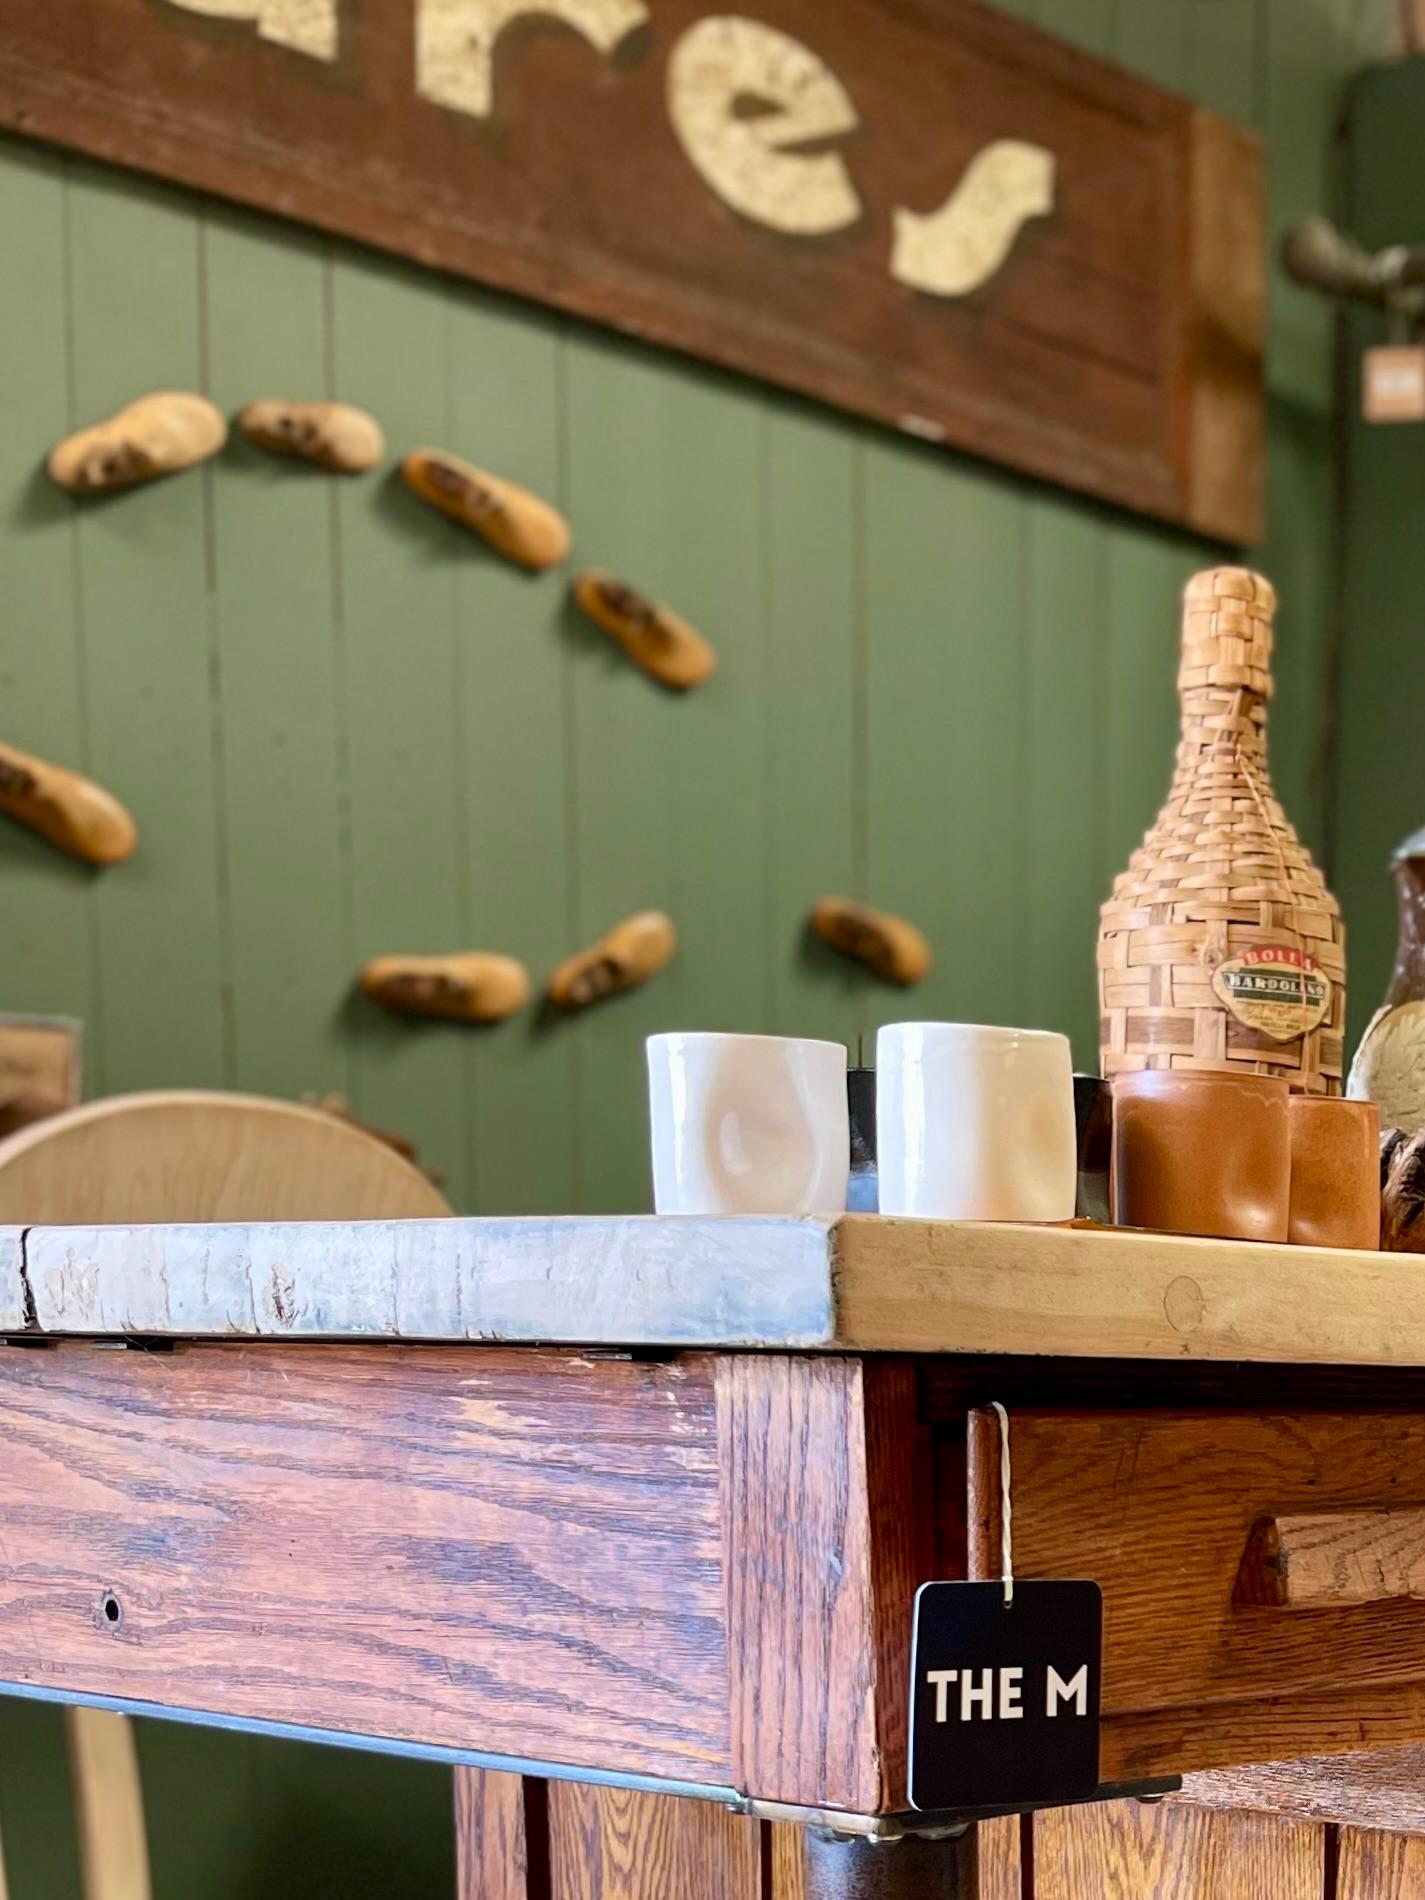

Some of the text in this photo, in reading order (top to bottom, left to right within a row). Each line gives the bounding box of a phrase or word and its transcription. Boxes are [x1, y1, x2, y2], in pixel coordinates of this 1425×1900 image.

[160, 0, 1055, 297] res
[926, 1663, 1089, 1723] THE M
